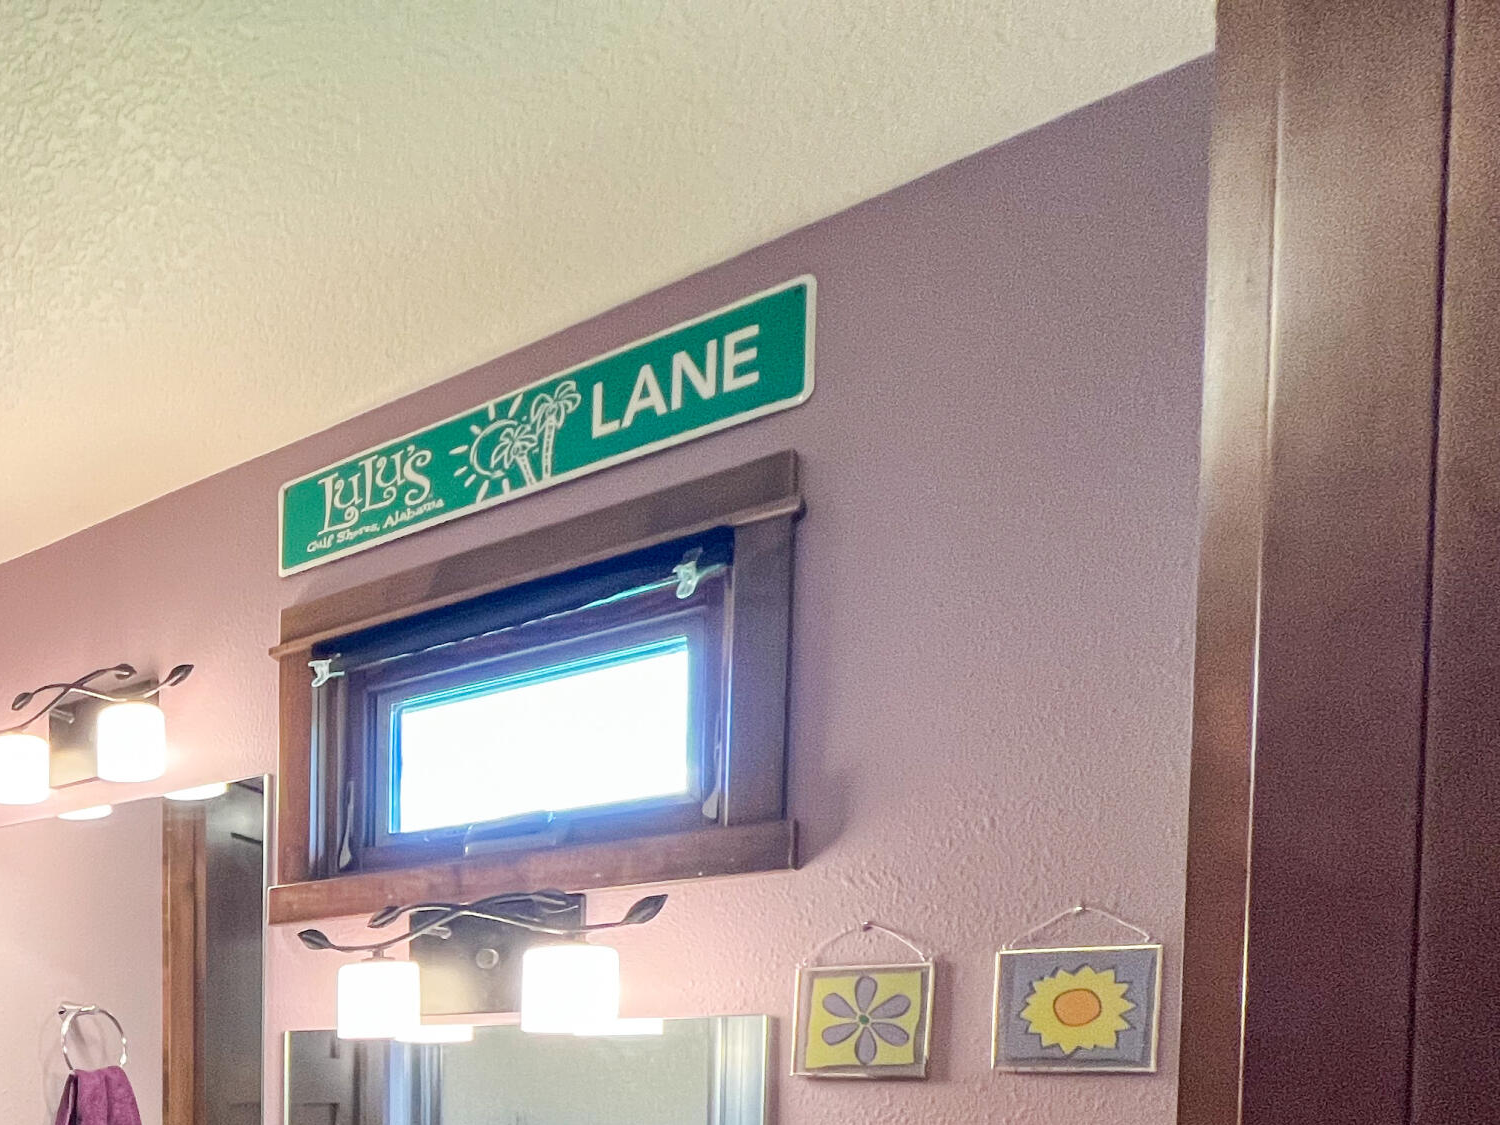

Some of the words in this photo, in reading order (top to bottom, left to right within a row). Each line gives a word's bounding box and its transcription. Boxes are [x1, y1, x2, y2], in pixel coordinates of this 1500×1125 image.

[591, 323, 760, 439] LANE
[306, 534, 334, 552] Gulf
[382, 498, 445, 529] Alabama
